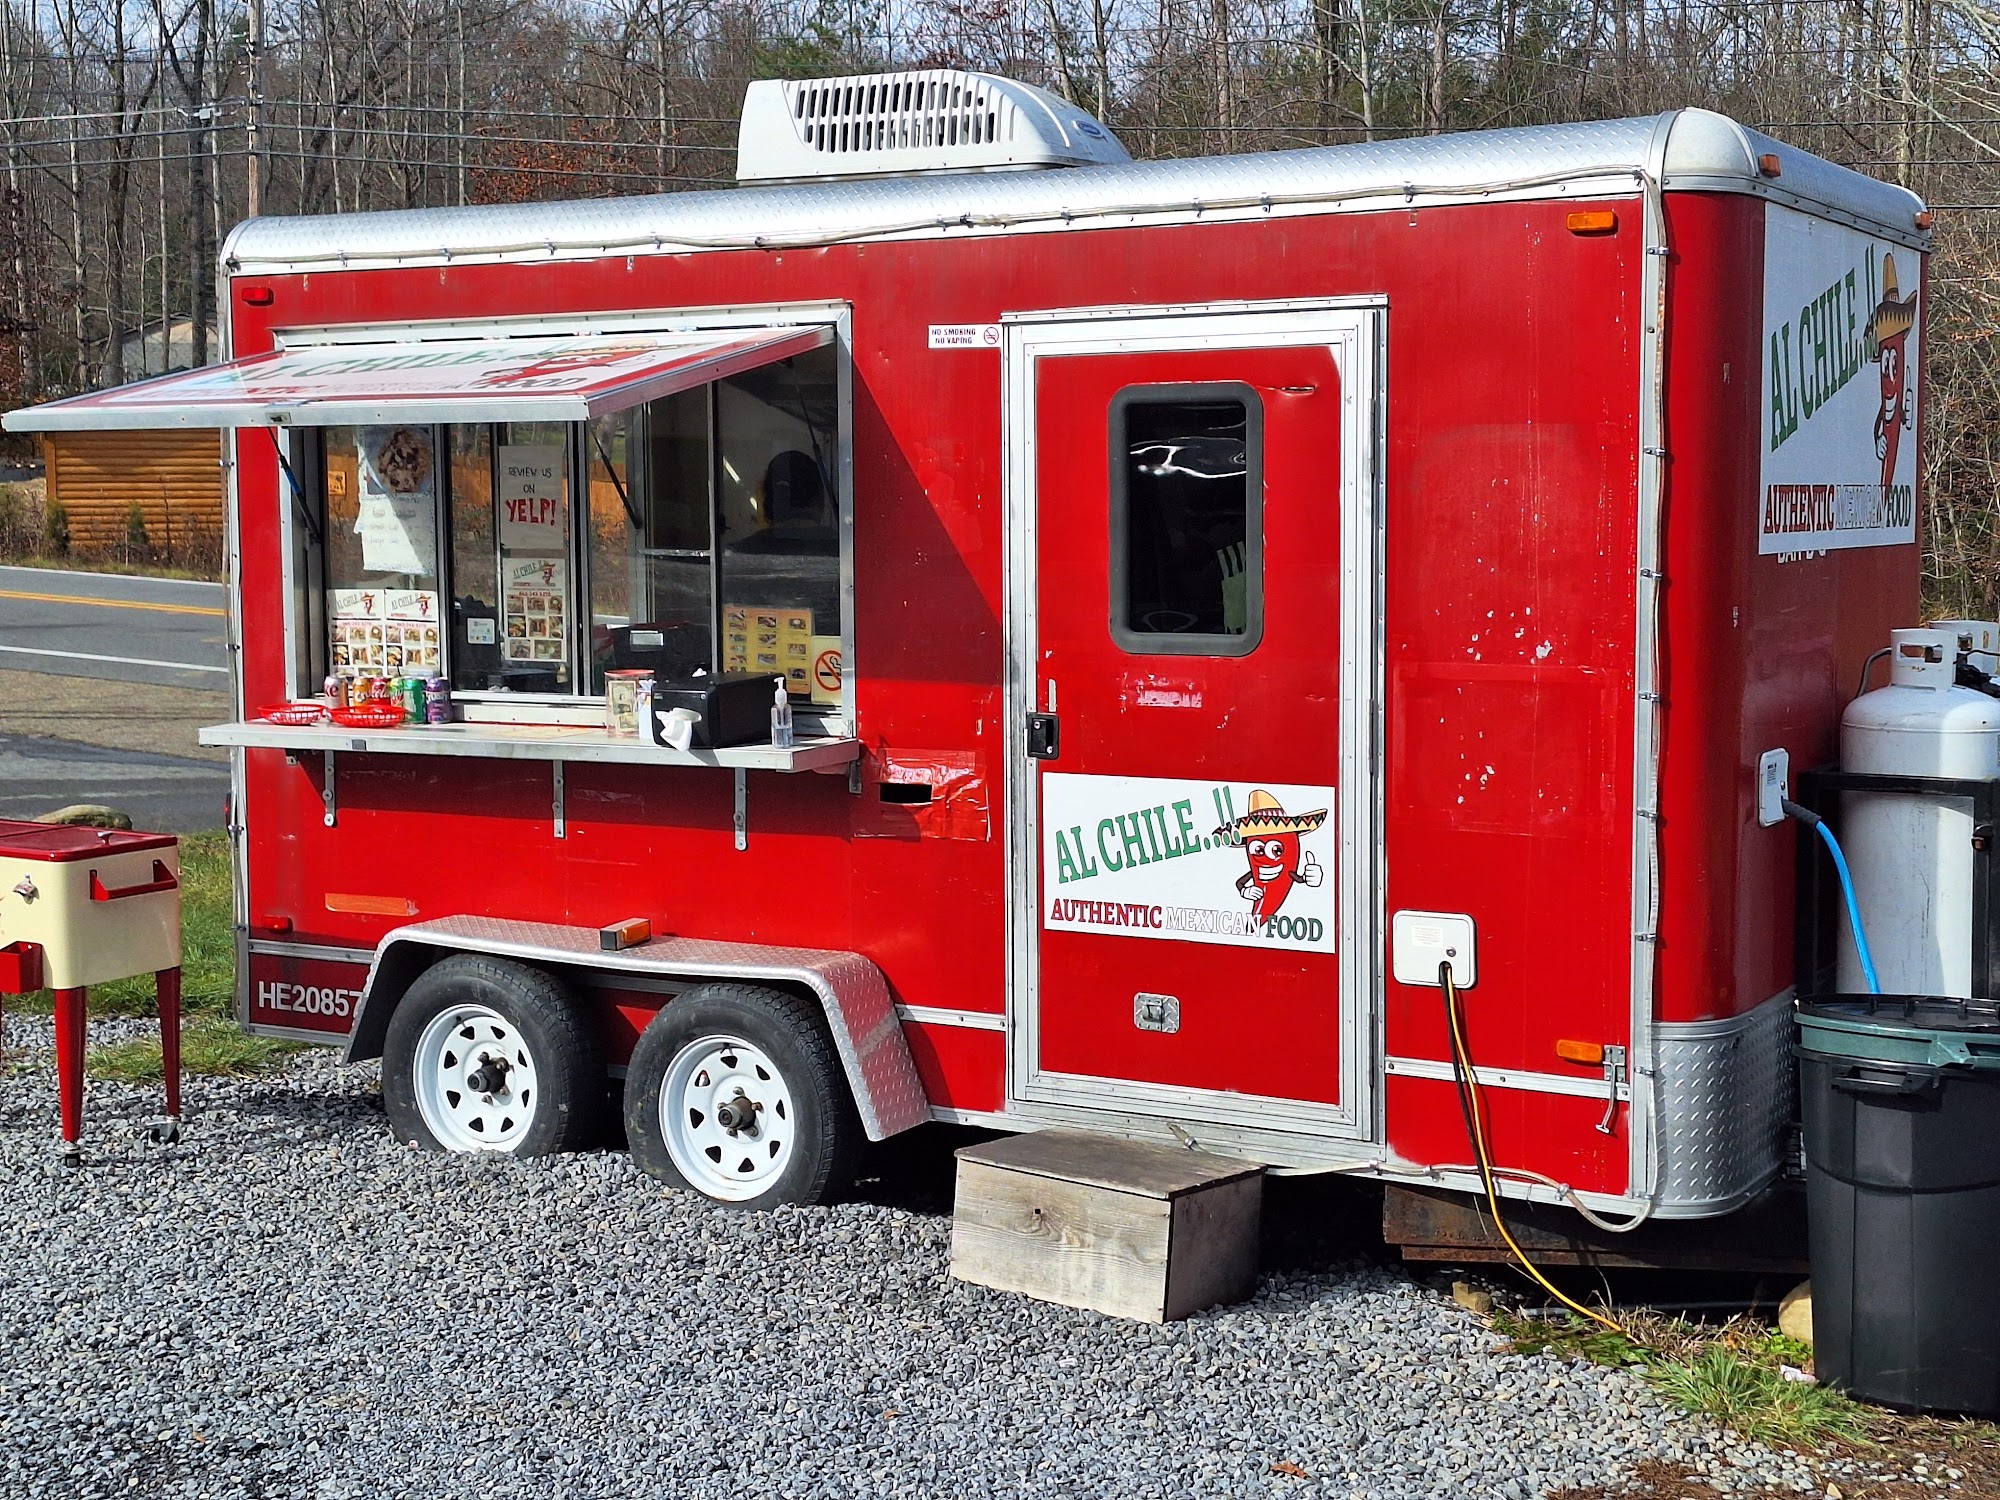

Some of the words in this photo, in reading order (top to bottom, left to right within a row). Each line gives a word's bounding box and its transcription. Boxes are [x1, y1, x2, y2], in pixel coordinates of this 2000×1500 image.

[931, 328, 942, 336] NO
[944, 328, 976, 336] SMOKING
[1771, 321, 1798, 453] AL
[508, 466, 538, 477] REVIEW
[541, 467, 552, 478] US
[523, 484, 535, 494] ON
[505, 498, 556, 526] YELP!
[1763, 484, 1835, 533] AUTHENTIC
[1835, 484, 1887, 530] MEXICAN
[1886, 485, 1912, 528] FOOD
[1055, 825, 1098, 884] AL
[1050, 898, 1162, 929] AUTHENTIC
[1165, 906, 1261, 937] MEXICAN
[1265, 915, 1323, 942] FOOD
